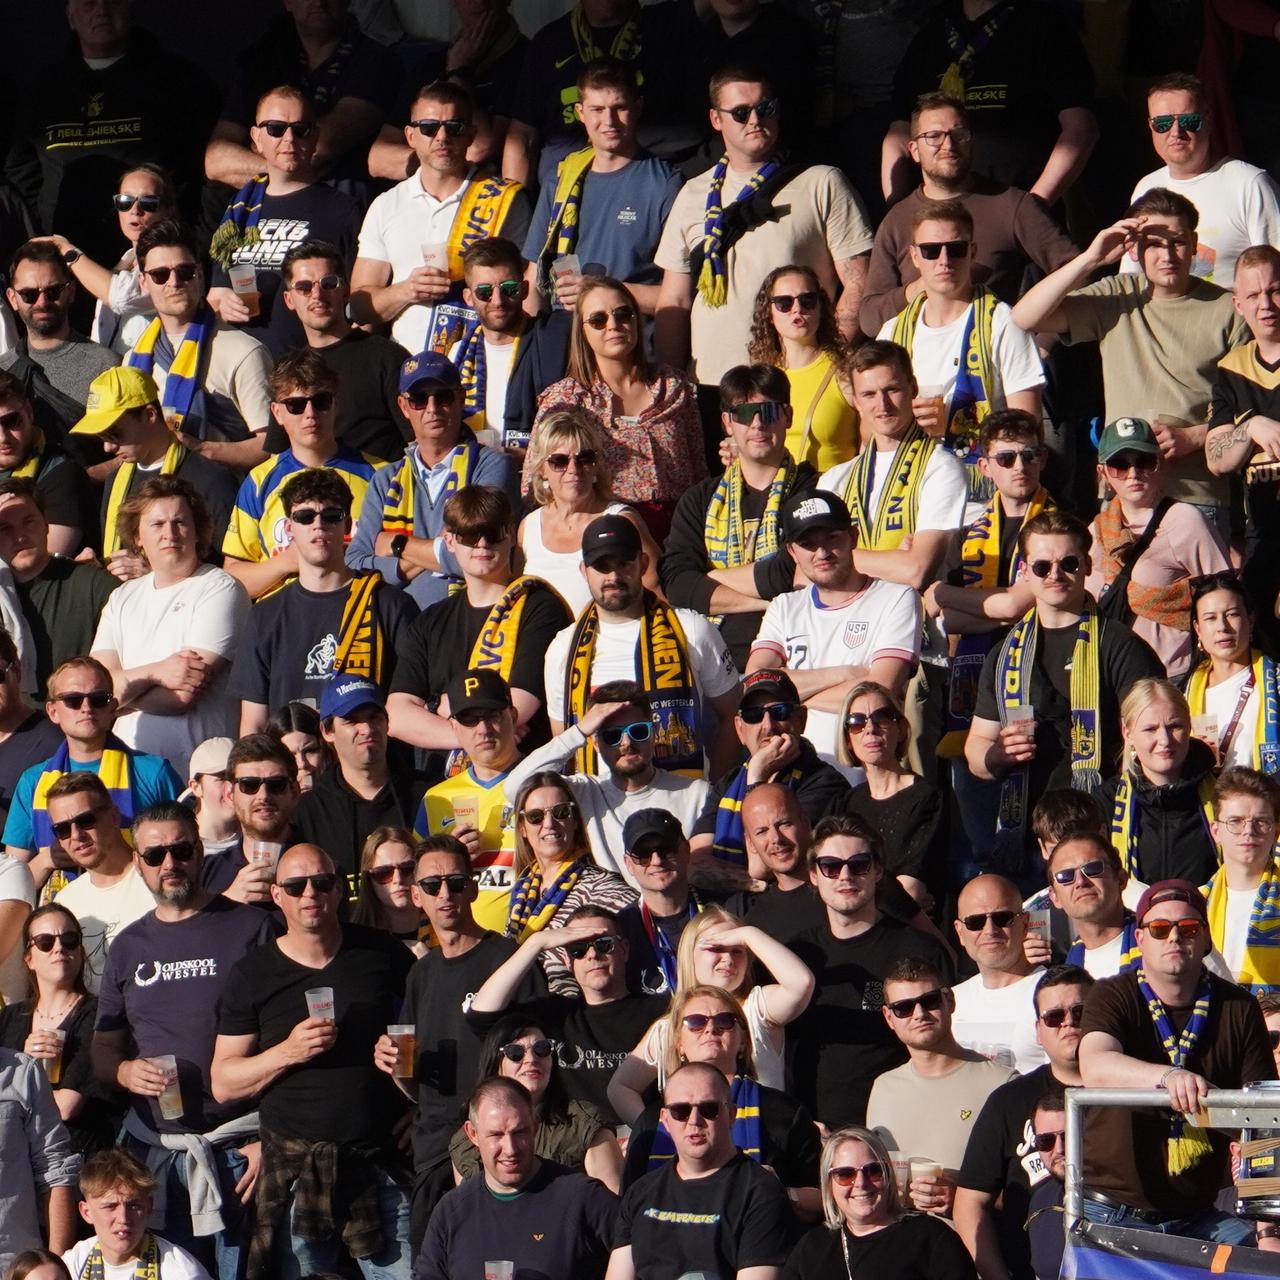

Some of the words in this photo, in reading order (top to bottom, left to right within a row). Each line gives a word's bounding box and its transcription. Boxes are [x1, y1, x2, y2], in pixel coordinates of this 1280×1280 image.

[848, 623, 867, 635] USA
[464, 676, 480, 698] P
[162, 958, 217, 972] OLDSKOOL
[162, 968, 217, 982] WESTEL
[585, 1050, 629, 1061] OLDSKO
[585, 1059, 624, 1069] WEST
